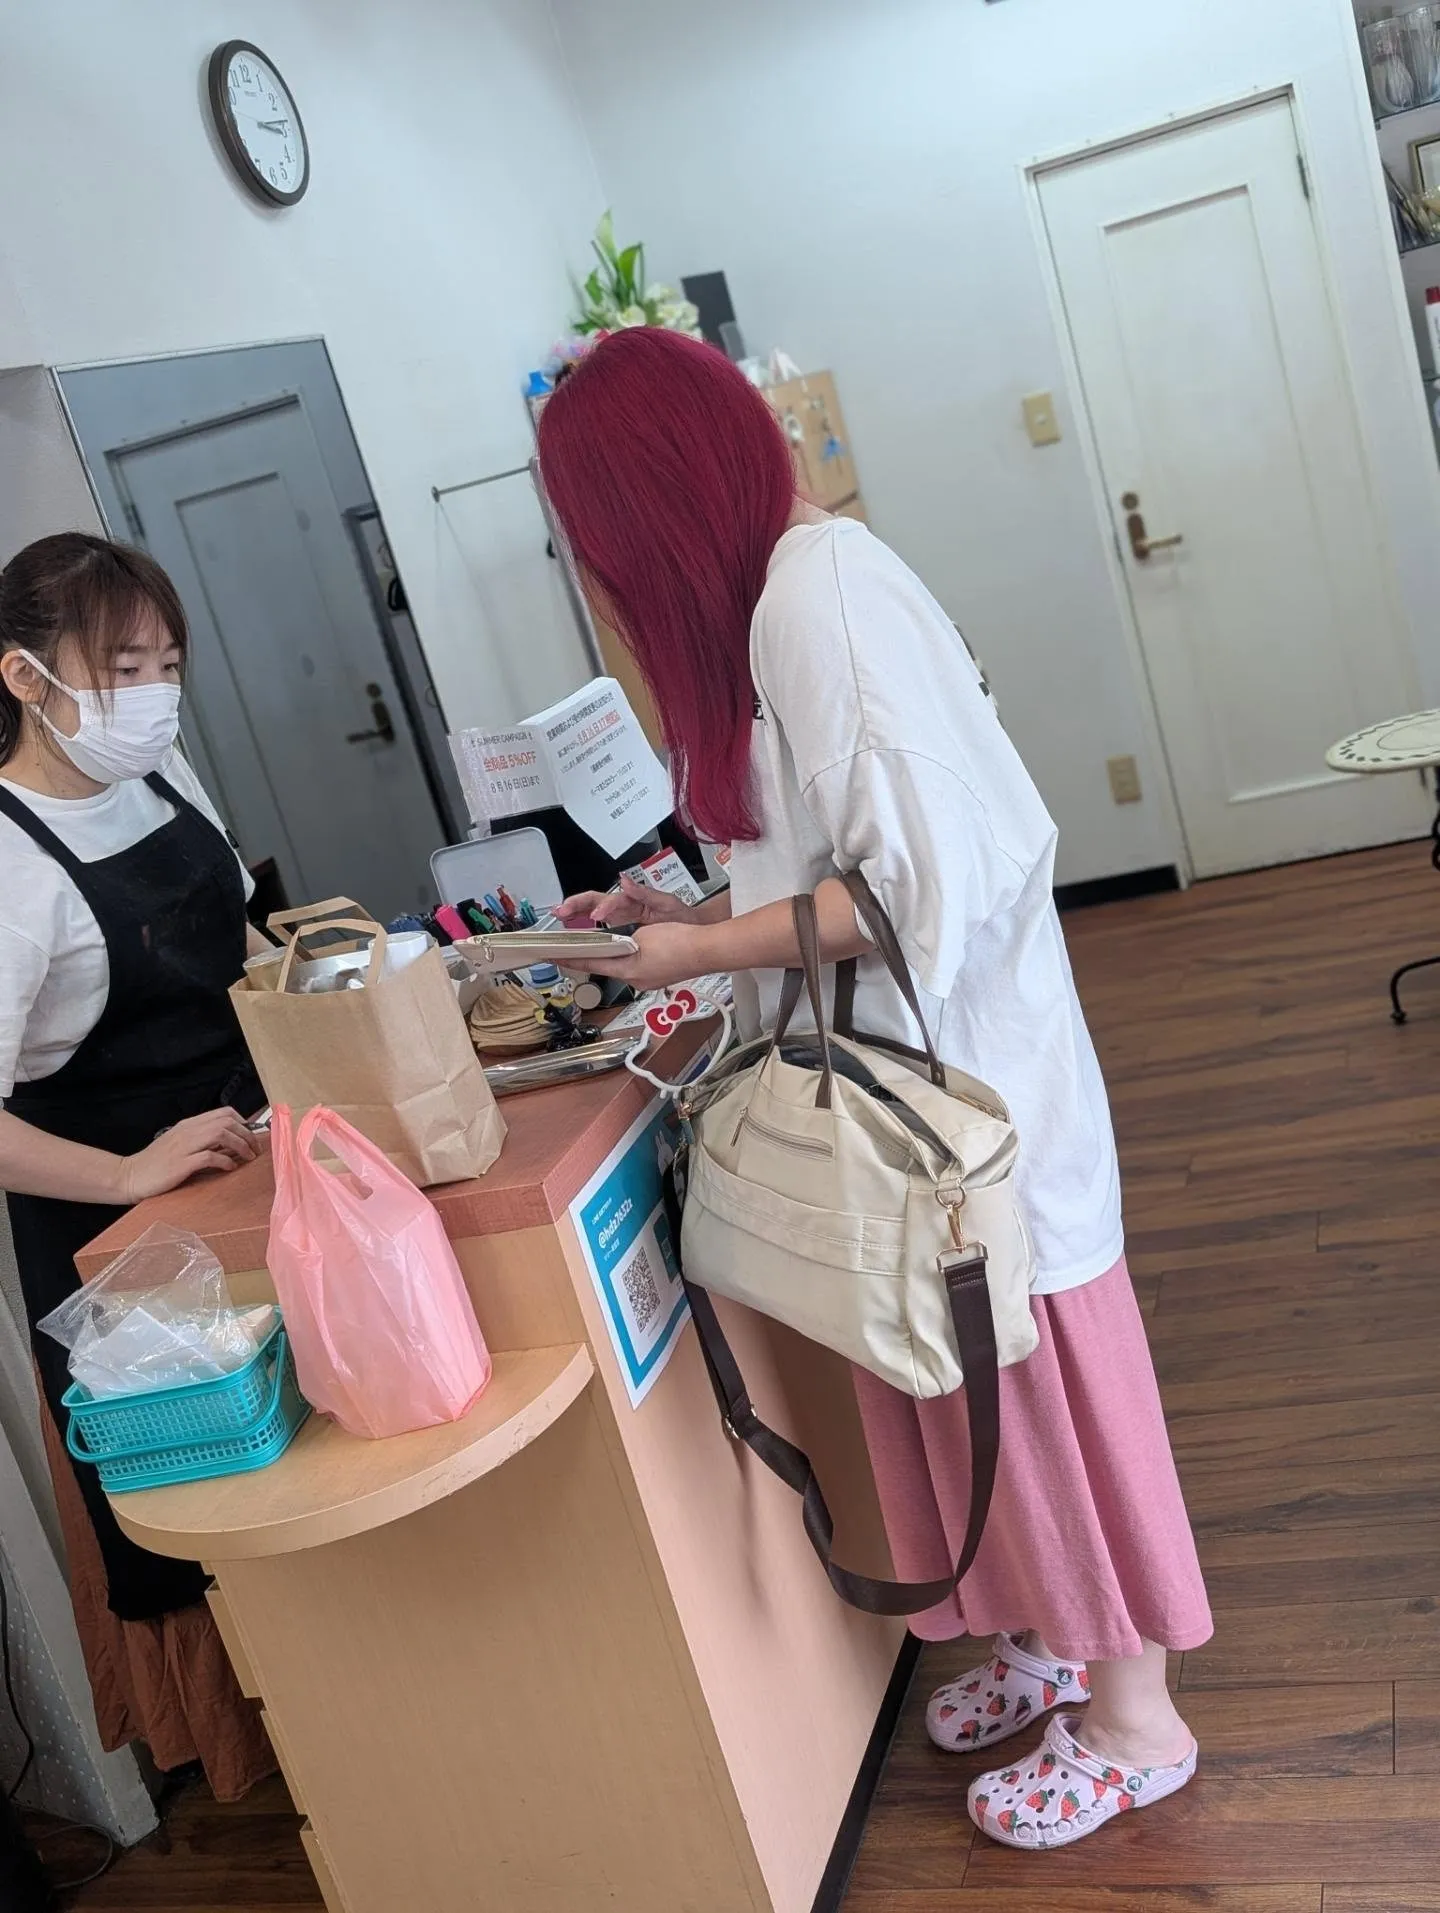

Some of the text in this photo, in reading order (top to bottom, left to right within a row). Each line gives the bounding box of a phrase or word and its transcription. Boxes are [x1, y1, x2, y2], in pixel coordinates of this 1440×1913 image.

[230, 69, 240, 88] 11
[238, 64, 252, 84] 12
[255, 74, 263, 92] 1
[268, 92, 278, 111] 2
[284, 144, 292, 163] 4
[269, 167, 278, 185] 6
[279, 162, 288, 180] 5
